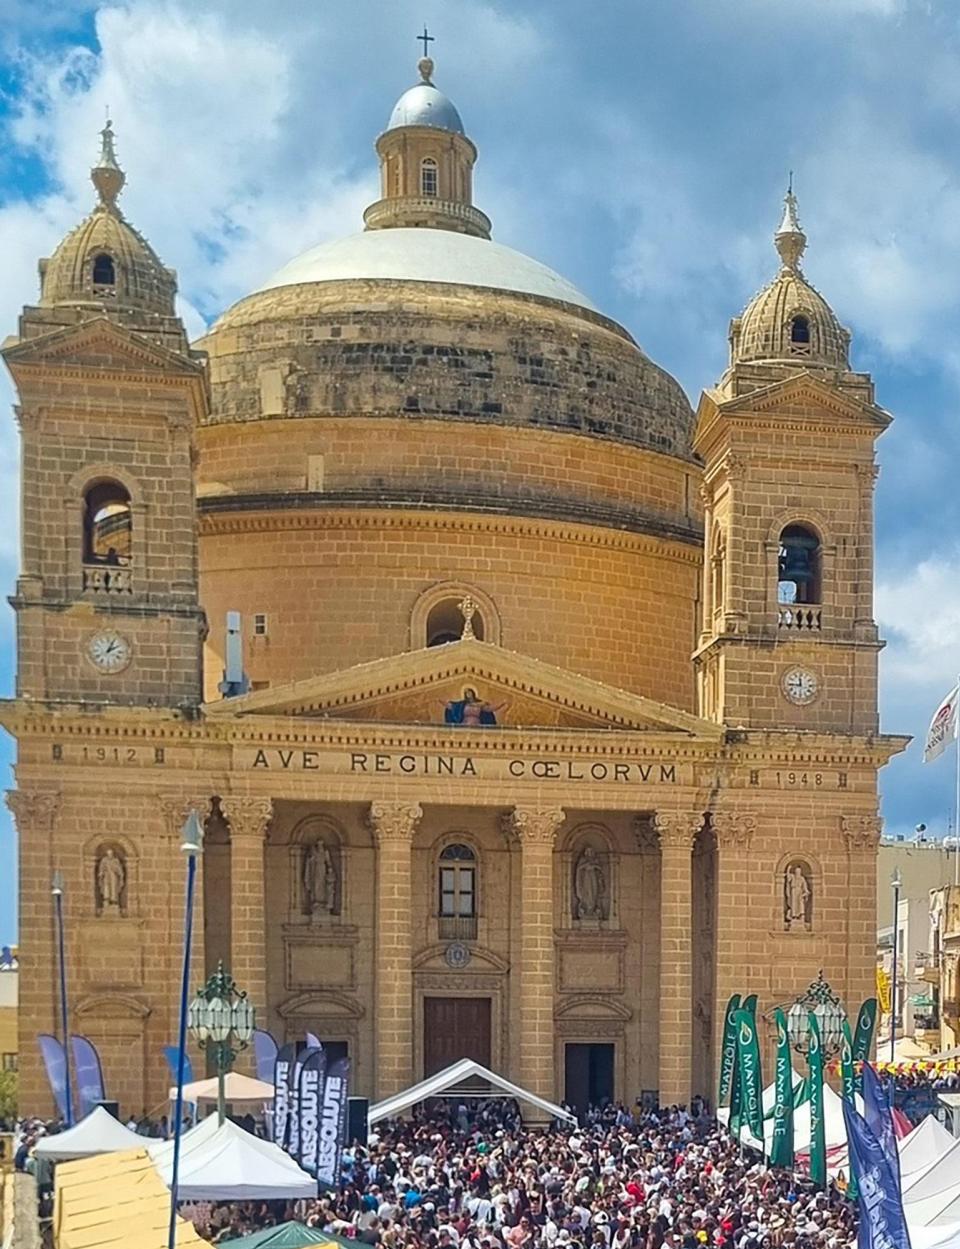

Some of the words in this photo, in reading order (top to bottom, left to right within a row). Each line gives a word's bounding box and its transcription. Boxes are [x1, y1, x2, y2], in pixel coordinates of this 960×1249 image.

[82, 746, 137, 763] 1912
[252, 749, 320, 769] AVE
[351, 754, 478, 776] REGINA
[775, 771, 823, 787] 1948
[721, 1033, 737, 1096] MAYPOLE
[742, 1053, 759, 1126] MAYPOLE
[774, 1057, 786, 1137] MAYPOLE
[301, 1070, 318, 1166] ABSOLUTE
[318, 1076, 342, 1185] ABSOLUTE
